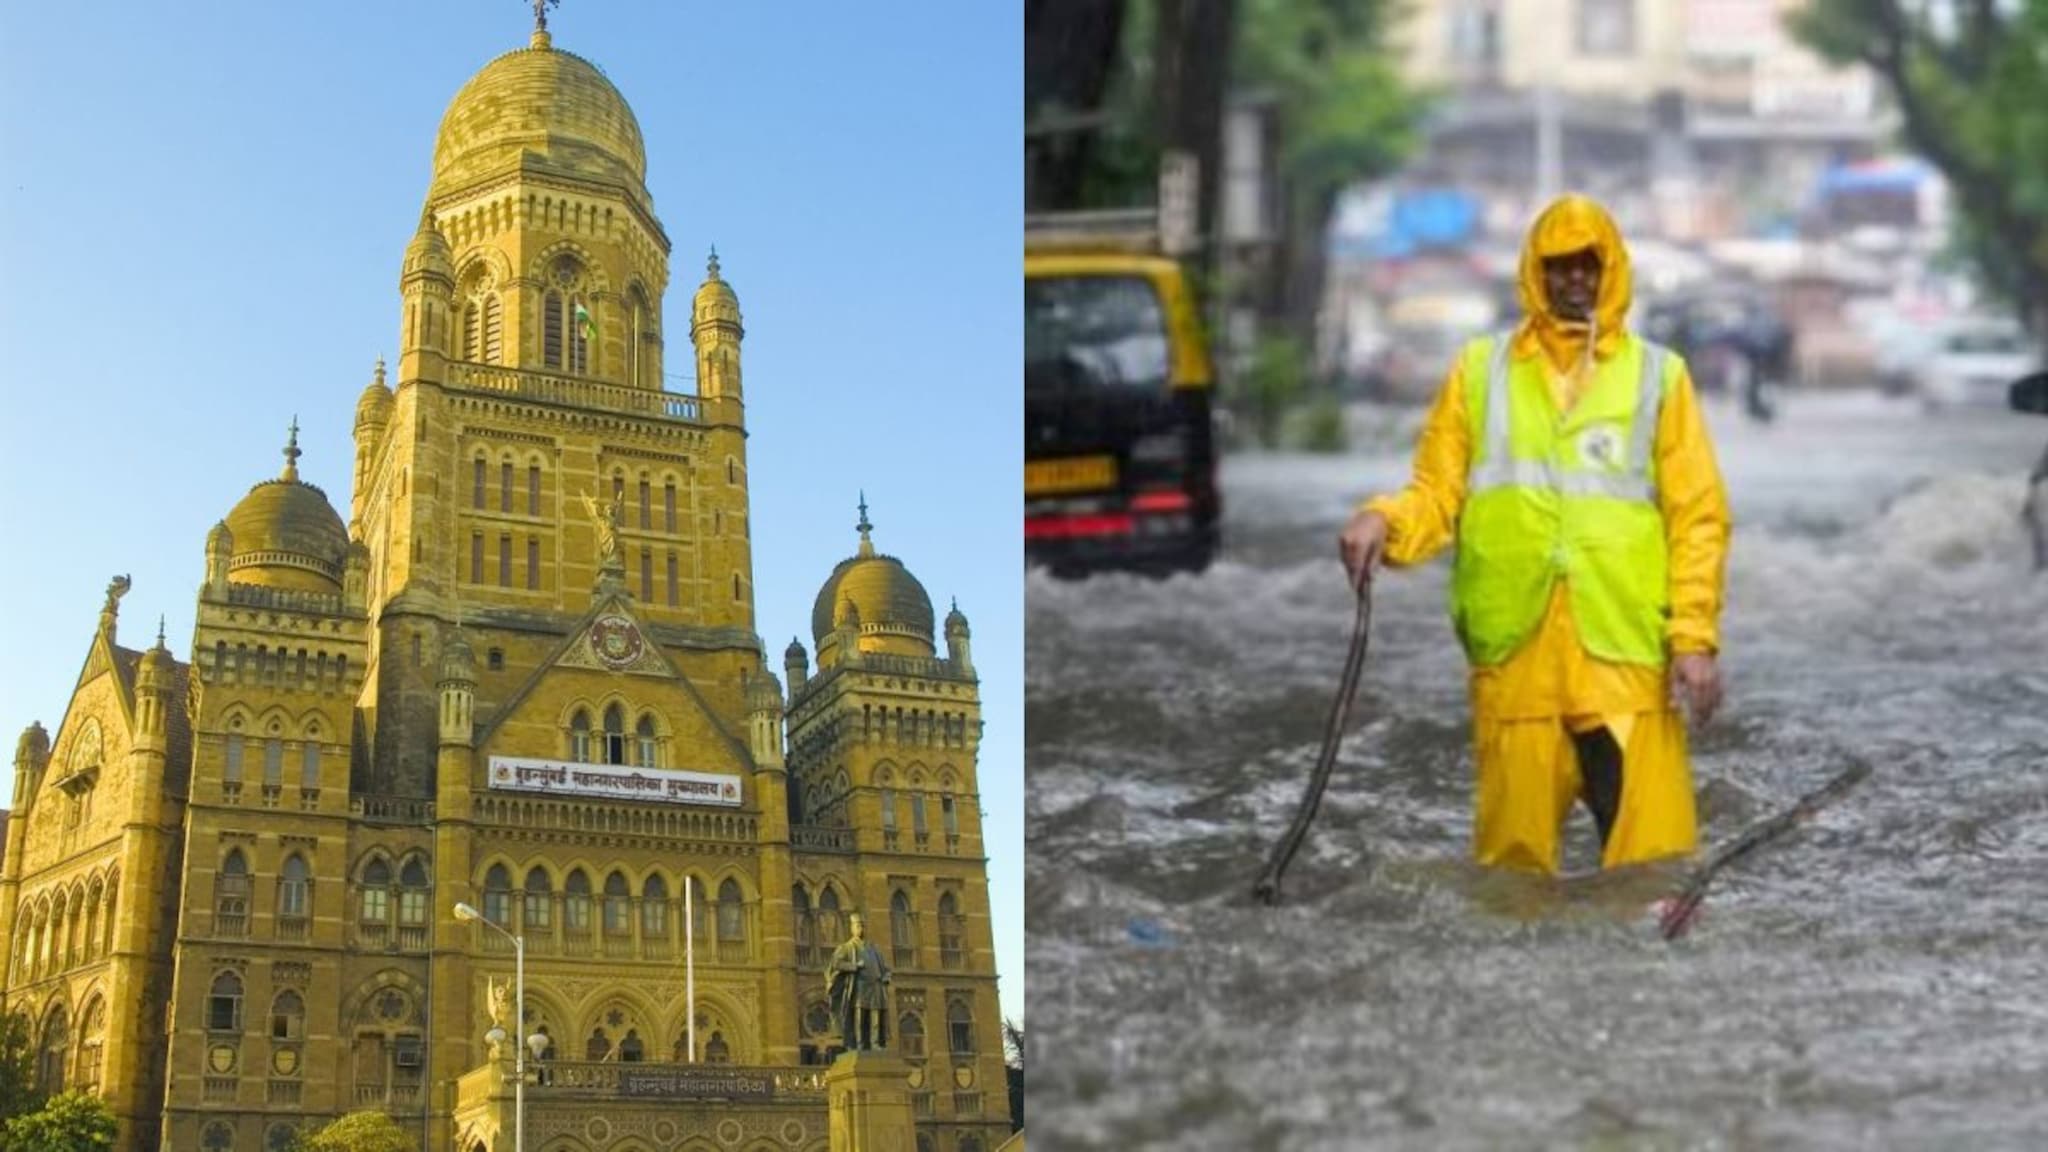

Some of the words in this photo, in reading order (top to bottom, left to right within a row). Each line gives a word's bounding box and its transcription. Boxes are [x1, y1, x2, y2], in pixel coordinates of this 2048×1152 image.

[516, 764, 567, 785] बृहन्मुंबई
[572, 771, 662, 792] महानगरपालिका
[667, 778, 719, 796] मुख्यालय
